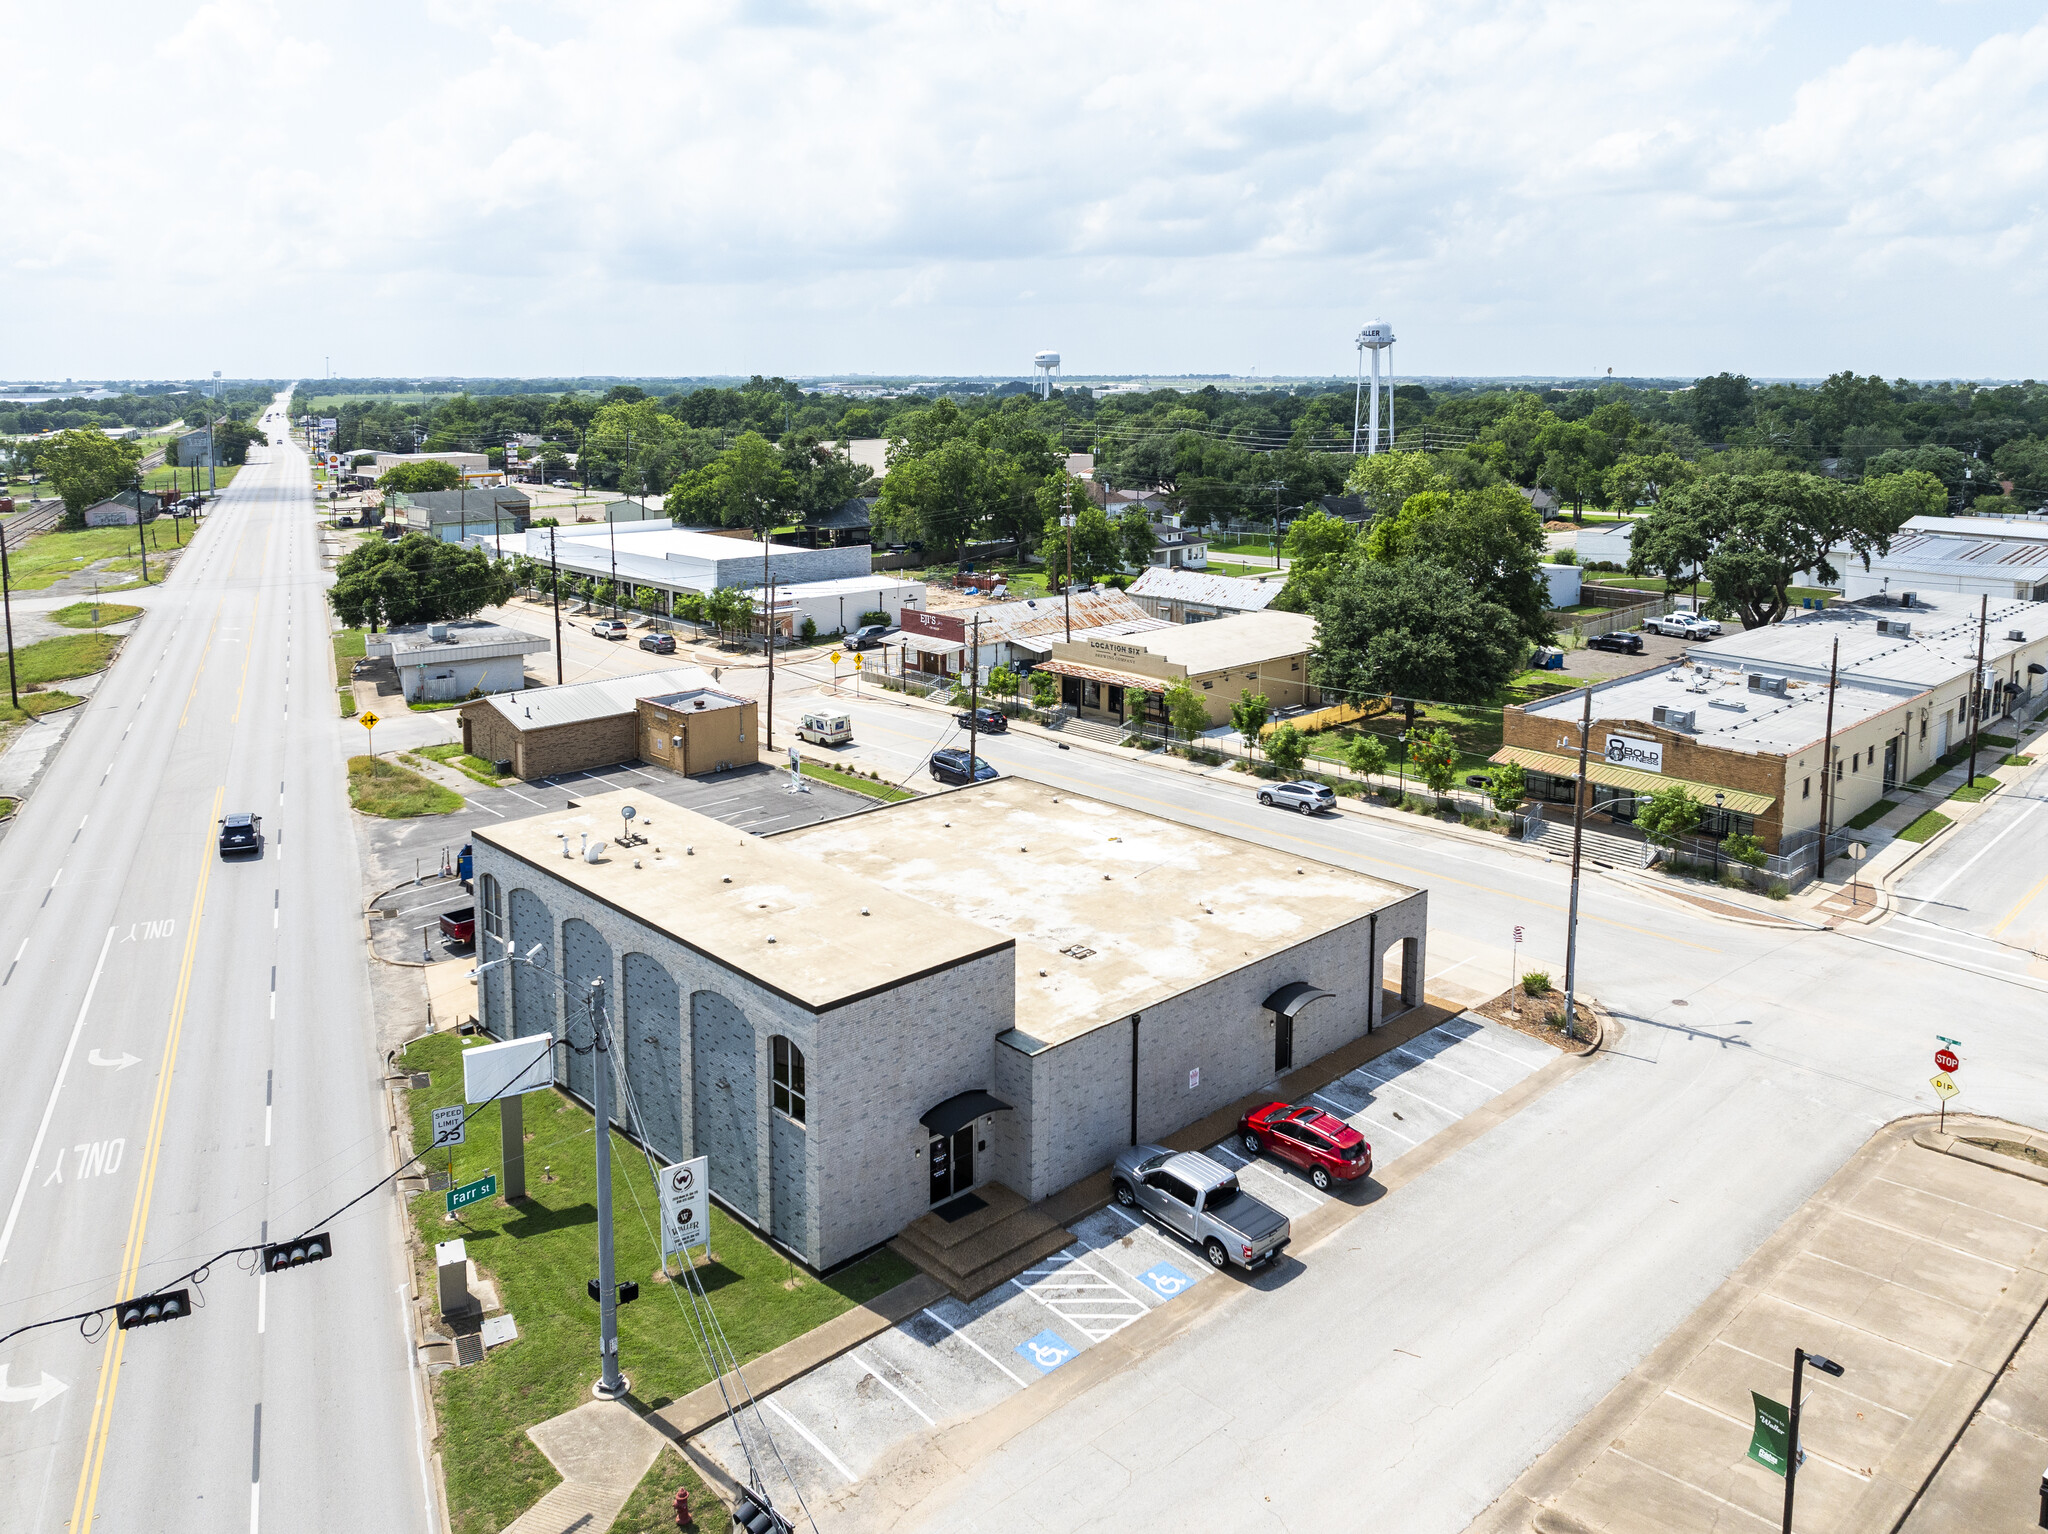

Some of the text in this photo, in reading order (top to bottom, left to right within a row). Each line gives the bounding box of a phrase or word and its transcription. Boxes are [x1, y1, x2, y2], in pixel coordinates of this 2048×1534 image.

[1090, 641, 1140, 655] LOCATION SIX
[1095, 653, 1136, 664] BREWING COMPANY
[1624, 746, 1659, 760] BOLD
[1623, 755, 1659, 766] FITNESS
[120, 918, 175, 943] ONLY
[1936, 1054, 1957, 1068] STOP
[1936, 1080, 1953, 1091] DIP
[435, 1109, 462, 1119] SPEED
[438, 1118, 459, 1128] LIMIT
[438, 1127, 461, 1143] 35
[42, 1138, 126, 1187] ONLY
[453, 1184, 490, 1205] Farr St
[671, 1221, 699, 1236] WALLER
[1759, 1415, 1786, 1435] Waller
